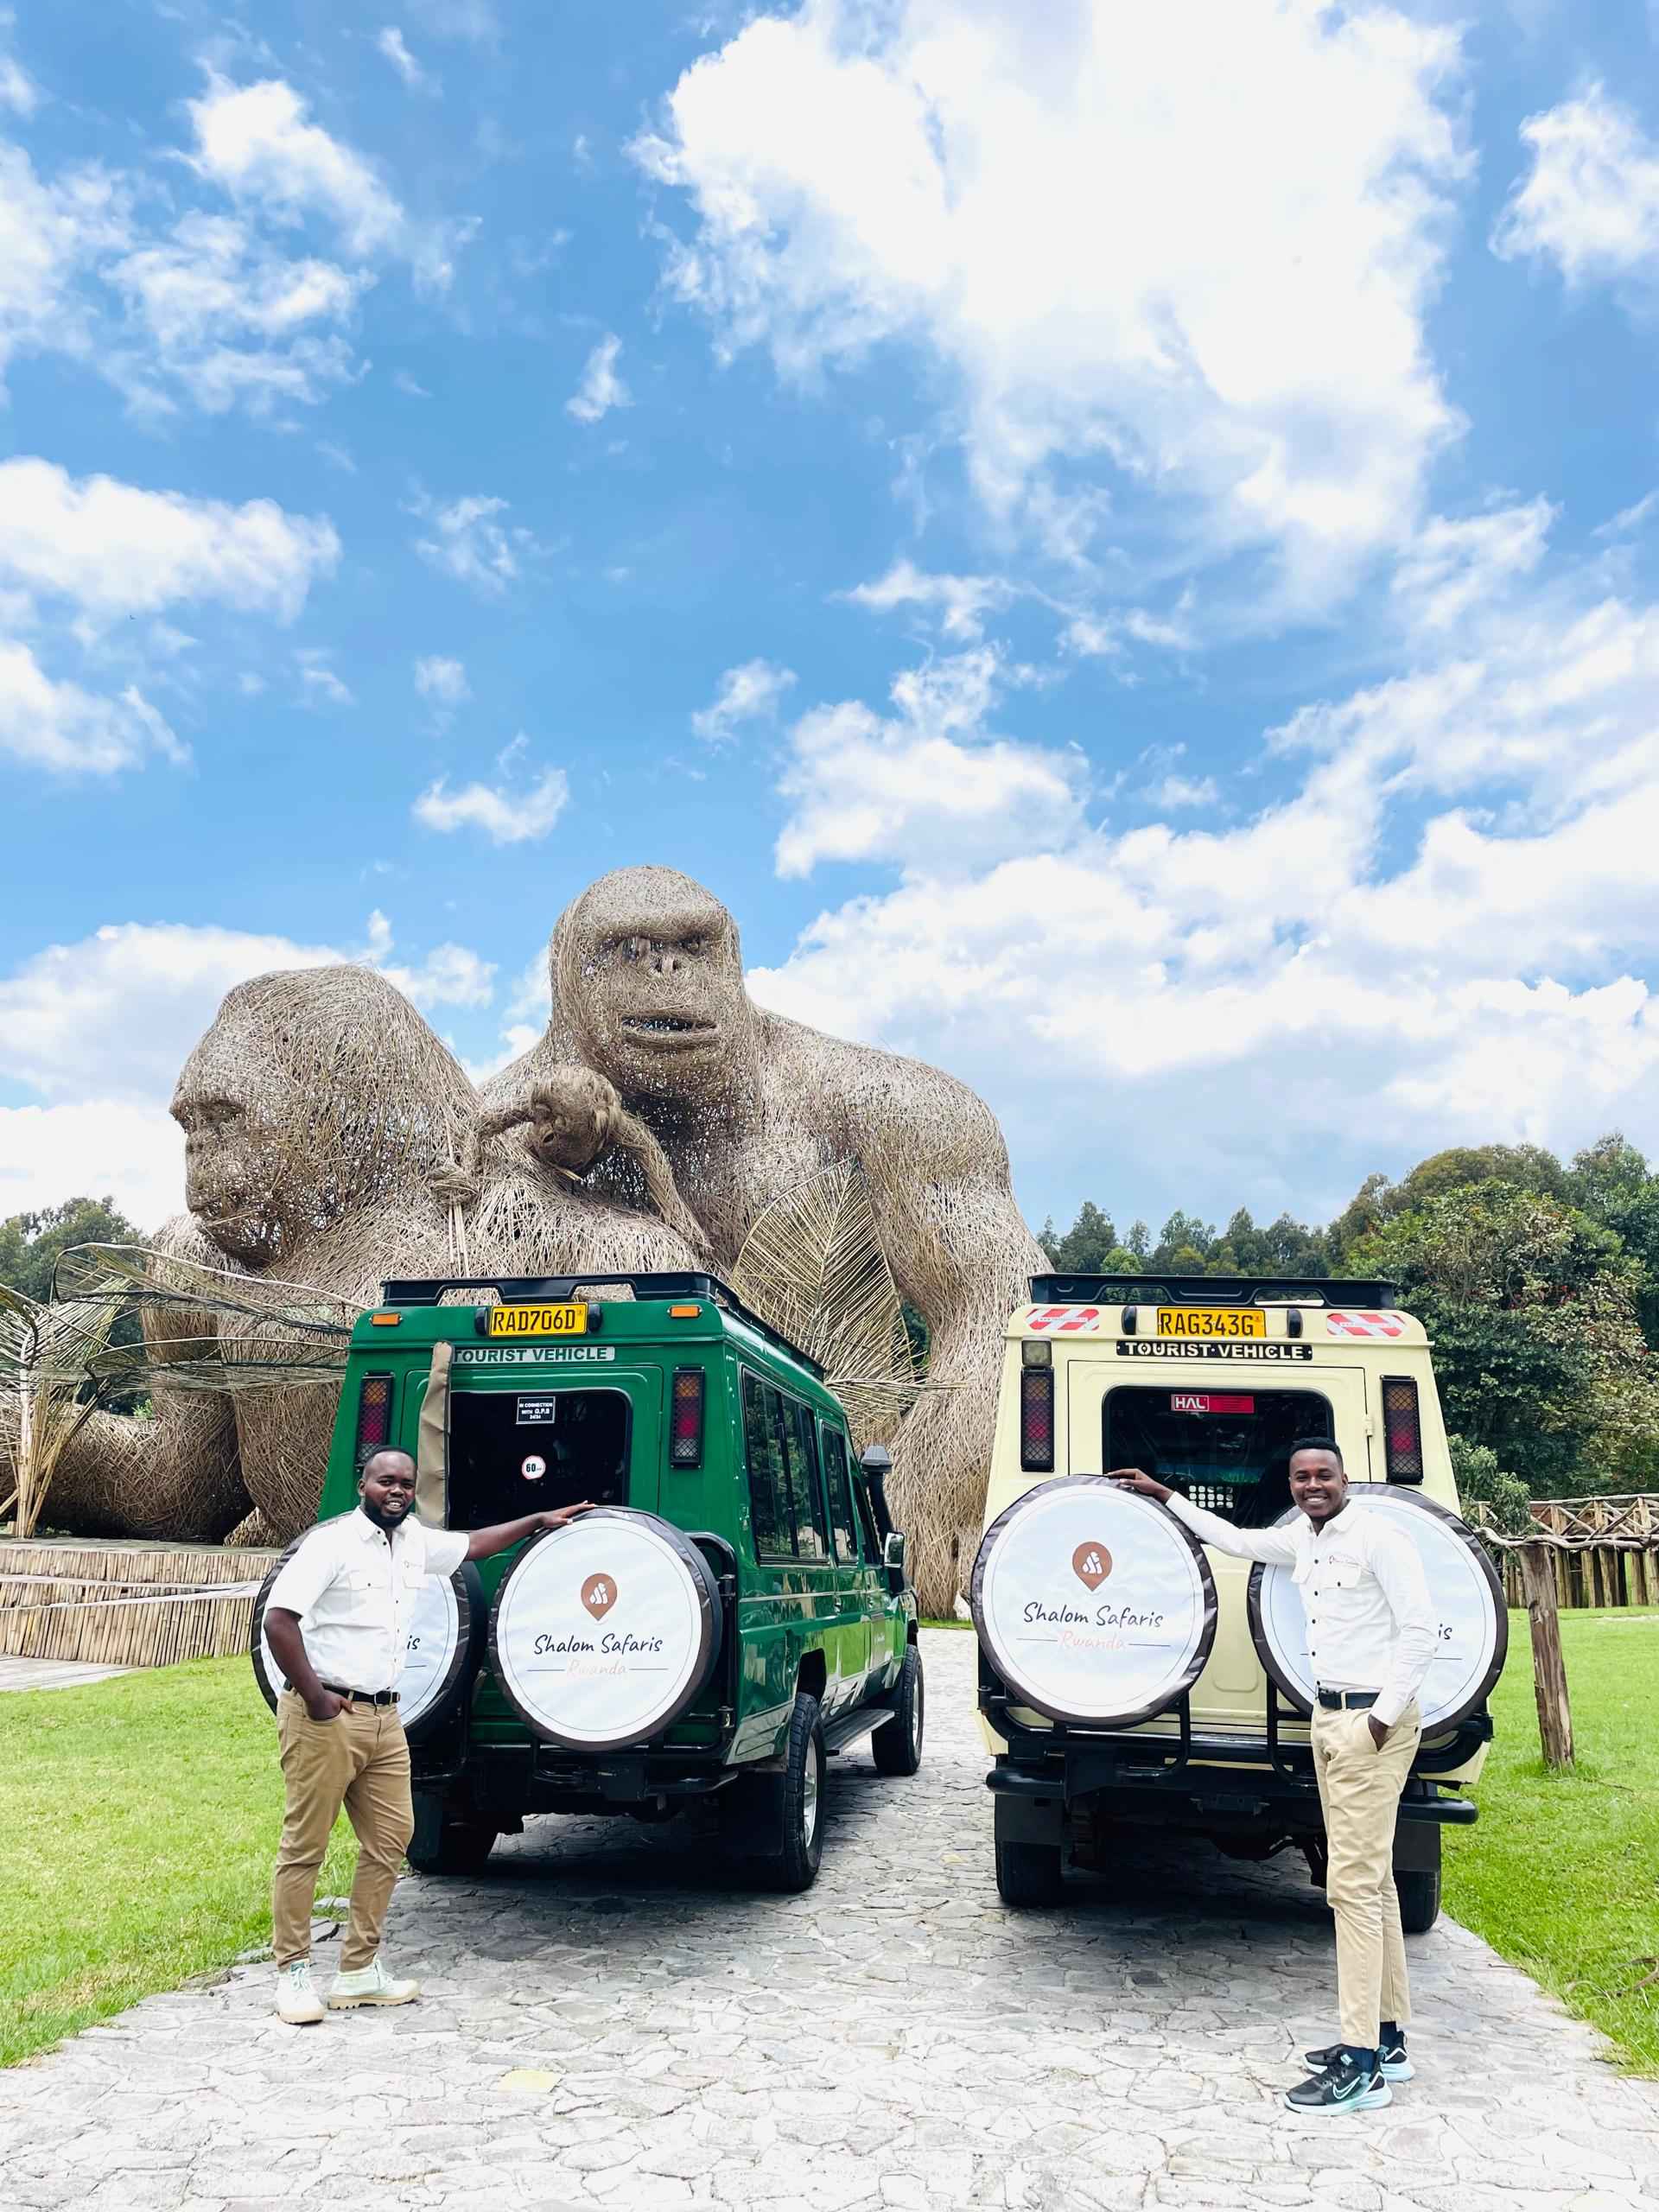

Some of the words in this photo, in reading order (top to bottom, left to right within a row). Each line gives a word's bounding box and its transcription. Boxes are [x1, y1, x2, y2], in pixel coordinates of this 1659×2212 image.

[493, 1309, 575, 1332] RAD706D
[1160, 1313, 1254, 1336] RAG343G
[454, 1349, 526, 1363] TOURIST
[532, 1347, 607, 1361] VEHICLE
[1125, 1342, 1211, 1357] TOURIST
[1217, 1344, 1304, 1359] VEHICLE
[1175, 1396, 1205, 1409] HAL
[525, 1463, 537, 1472] 60
[1023, 1601, 1090, 1623] Shalom
[1096, 1605, 1164, 1628] Safaris
[533, 1634, 594, 1655] Shalom
[601, 1633, 664, 1655] Safaris
[1059, 1630, 1124, 1650] Rwanda
